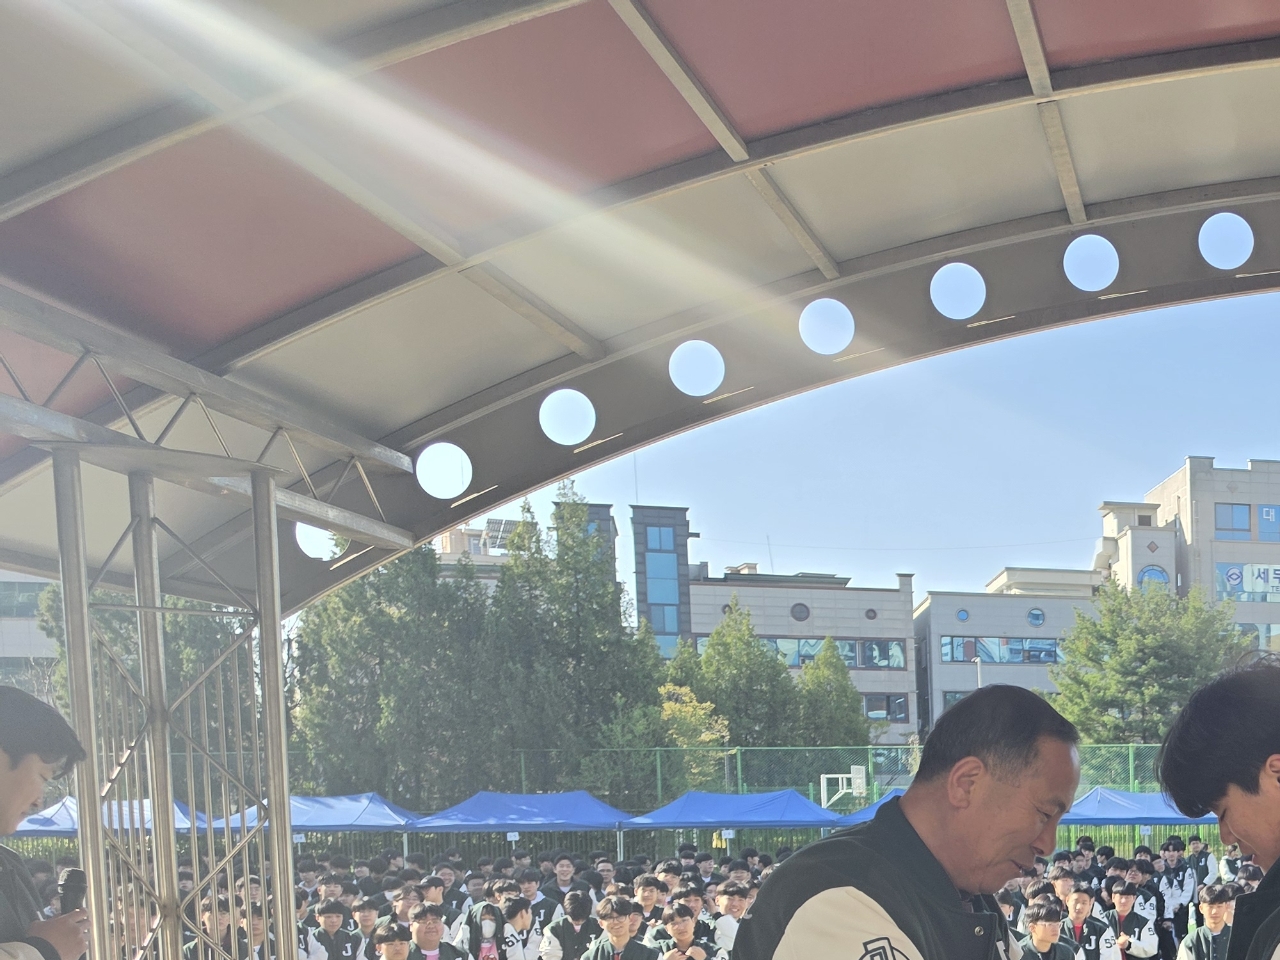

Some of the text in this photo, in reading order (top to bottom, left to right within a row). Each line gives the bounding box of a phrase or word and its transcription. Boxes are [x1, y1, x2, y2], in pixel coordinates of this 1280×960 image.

[535, 909, 546, 922] J
[1085, 935, 1096, 950] J
[342, 943, 352, 957] J
